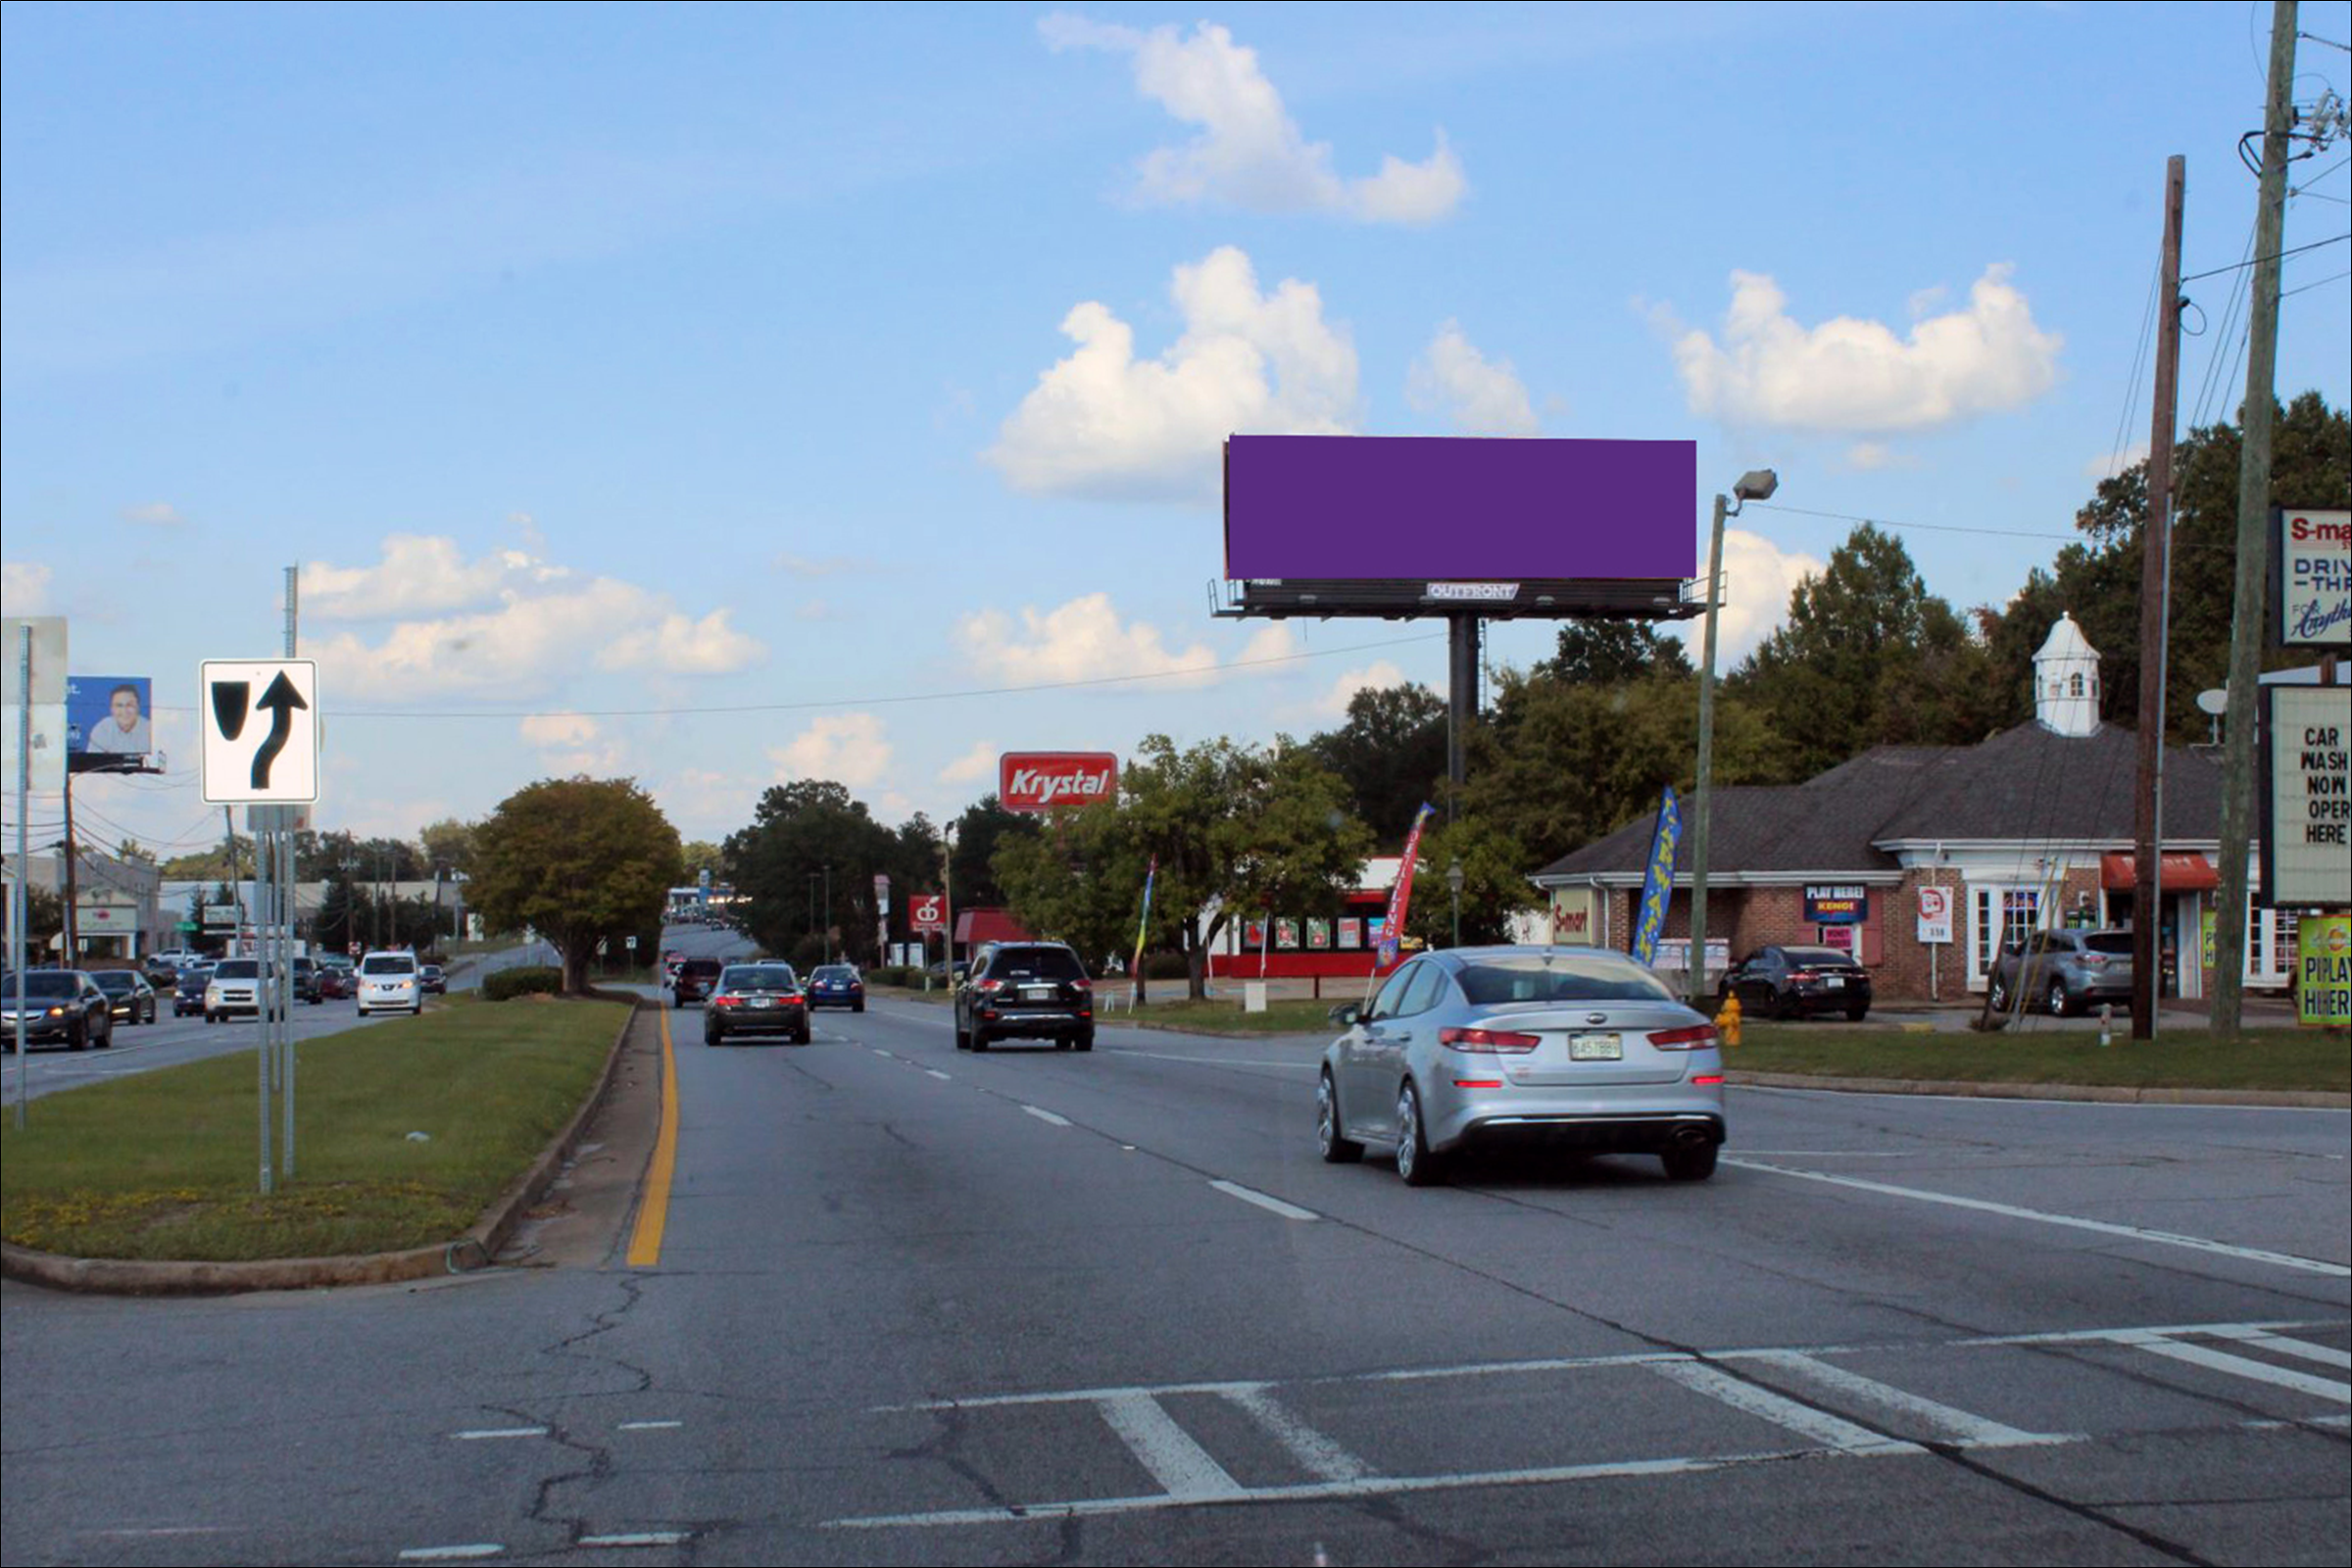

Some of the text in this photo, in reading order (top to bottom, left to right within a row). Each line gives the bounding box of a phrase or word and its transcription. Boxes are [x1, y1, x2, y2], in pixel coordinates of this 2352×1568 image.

[1431, 585, 1510, 597] OUTFRONT
[2305, 728, 2338, 746] CAR
[2300, 752, 2348, 770] WASH
[1009, 768, 1109, 804] Krystal
[2307, 776, 2346, 795] NOW
[2306, 825, 2347, 844] HERE
[1806, 886, 1832, 900] PLAY
